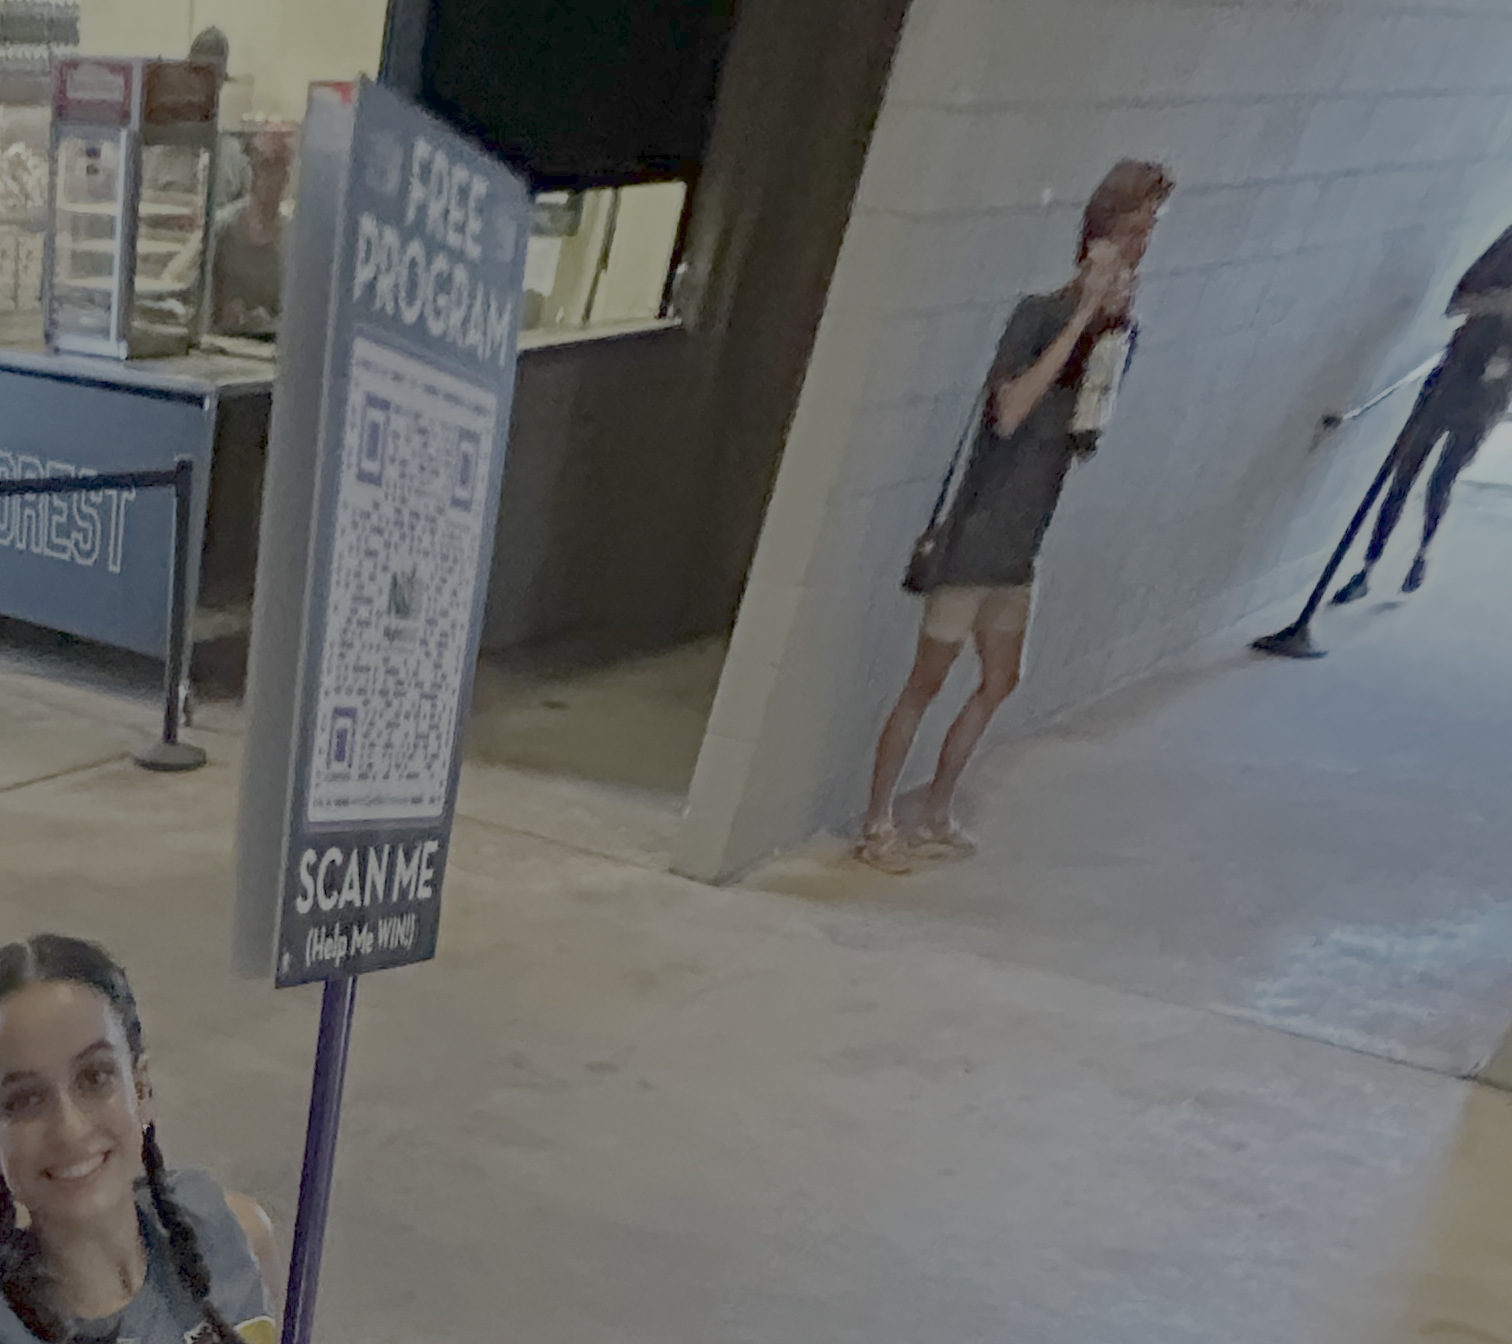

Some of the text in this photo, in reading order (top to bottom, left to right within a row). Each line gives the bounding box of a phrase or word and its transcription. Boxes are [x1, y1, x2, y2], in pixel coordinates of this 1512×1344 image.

[405, 136, 489, 261] FREE
[352, 211, 512, 368] PROGRAM
[296, 840, 438, 914] SCAN ME
[306, 922, 348, 968] (Help
[349, 923, 374, 956] Me
